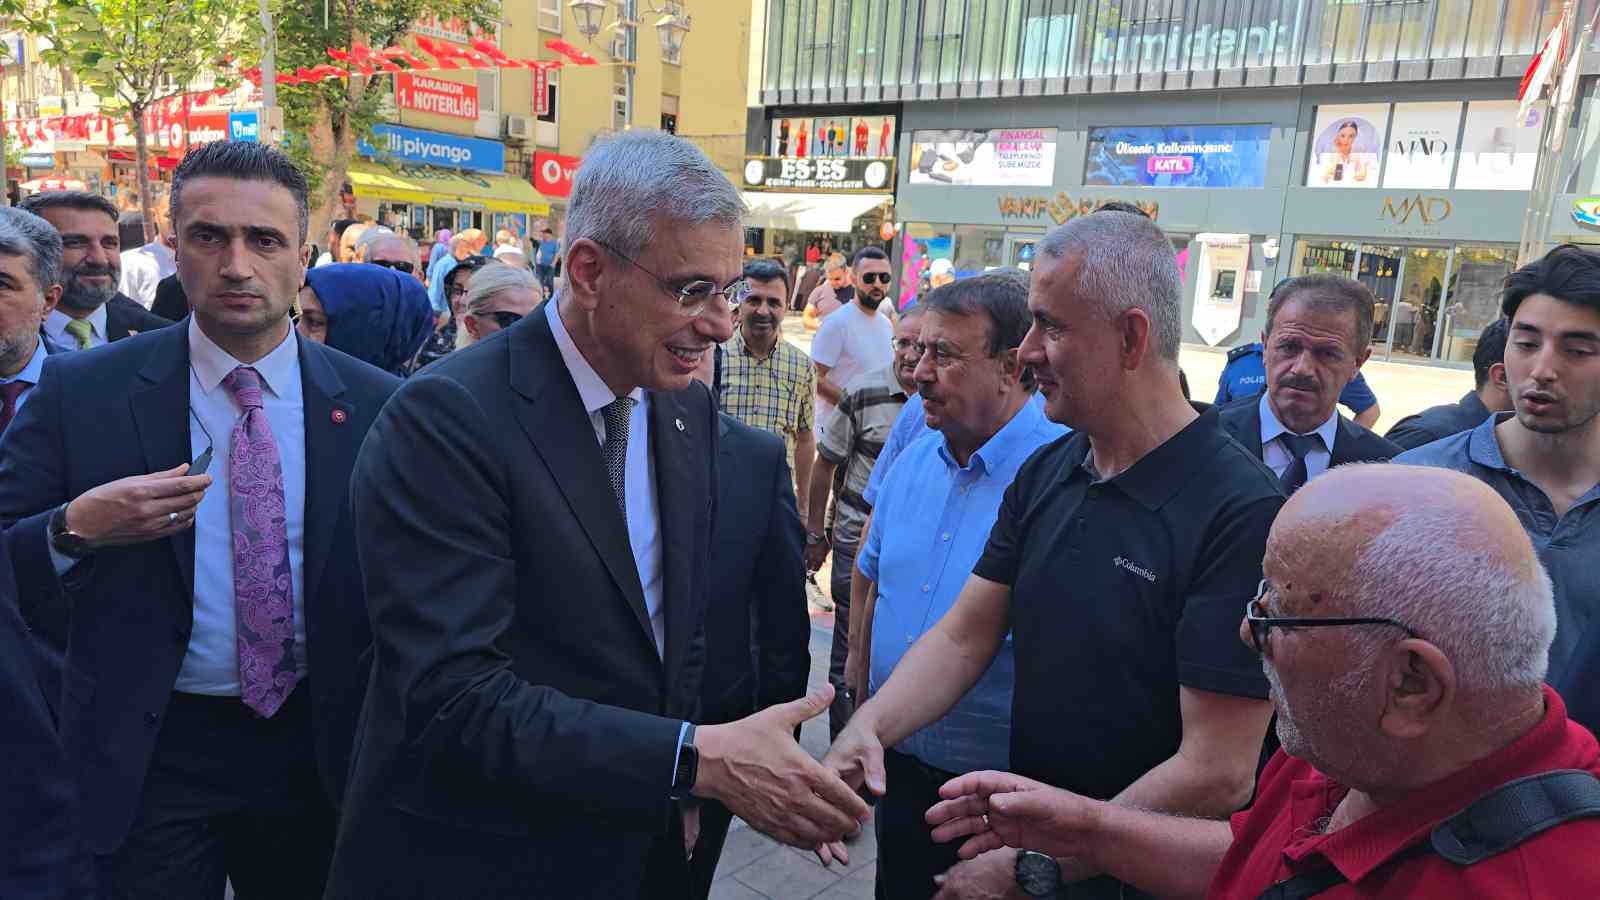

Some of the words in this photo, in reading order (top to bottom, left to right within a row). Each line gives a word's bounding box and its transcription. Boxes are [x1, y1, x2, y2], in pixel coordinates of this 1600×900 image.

[404, 138, 472, 162] piyango
[1153, 159, 1185, 171] KATIL
[1121, 558, 1156, 582] Columbia
